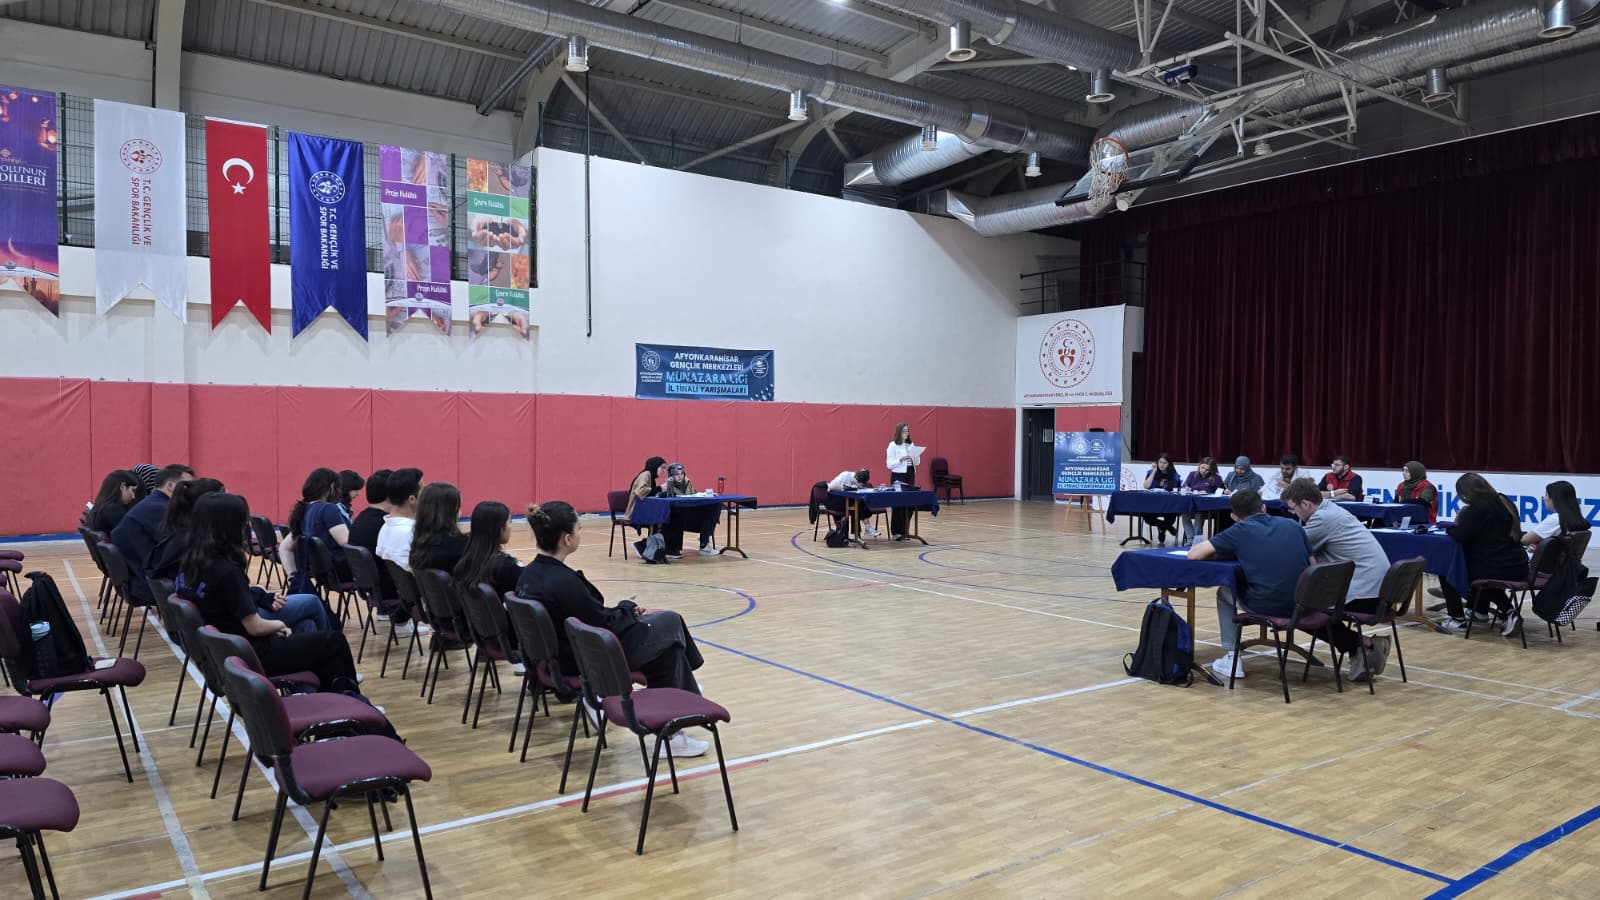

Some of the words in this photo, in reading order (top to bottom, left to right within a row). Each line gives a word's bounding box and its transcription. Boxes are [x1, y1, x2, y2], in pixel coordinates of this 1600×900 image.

[131, 176, 140, 199] SPOR
[320, 206, 328, 227] SPOR
[143, 235, 152, 246] VE
[330, 259, 339, 270] VE
[674, 352, 739, 363] AFYONKARAHİSAR
[670, 361, 700, 371] GENÇLİK
[702, 362, 744, 371] MERKEZLERİ
